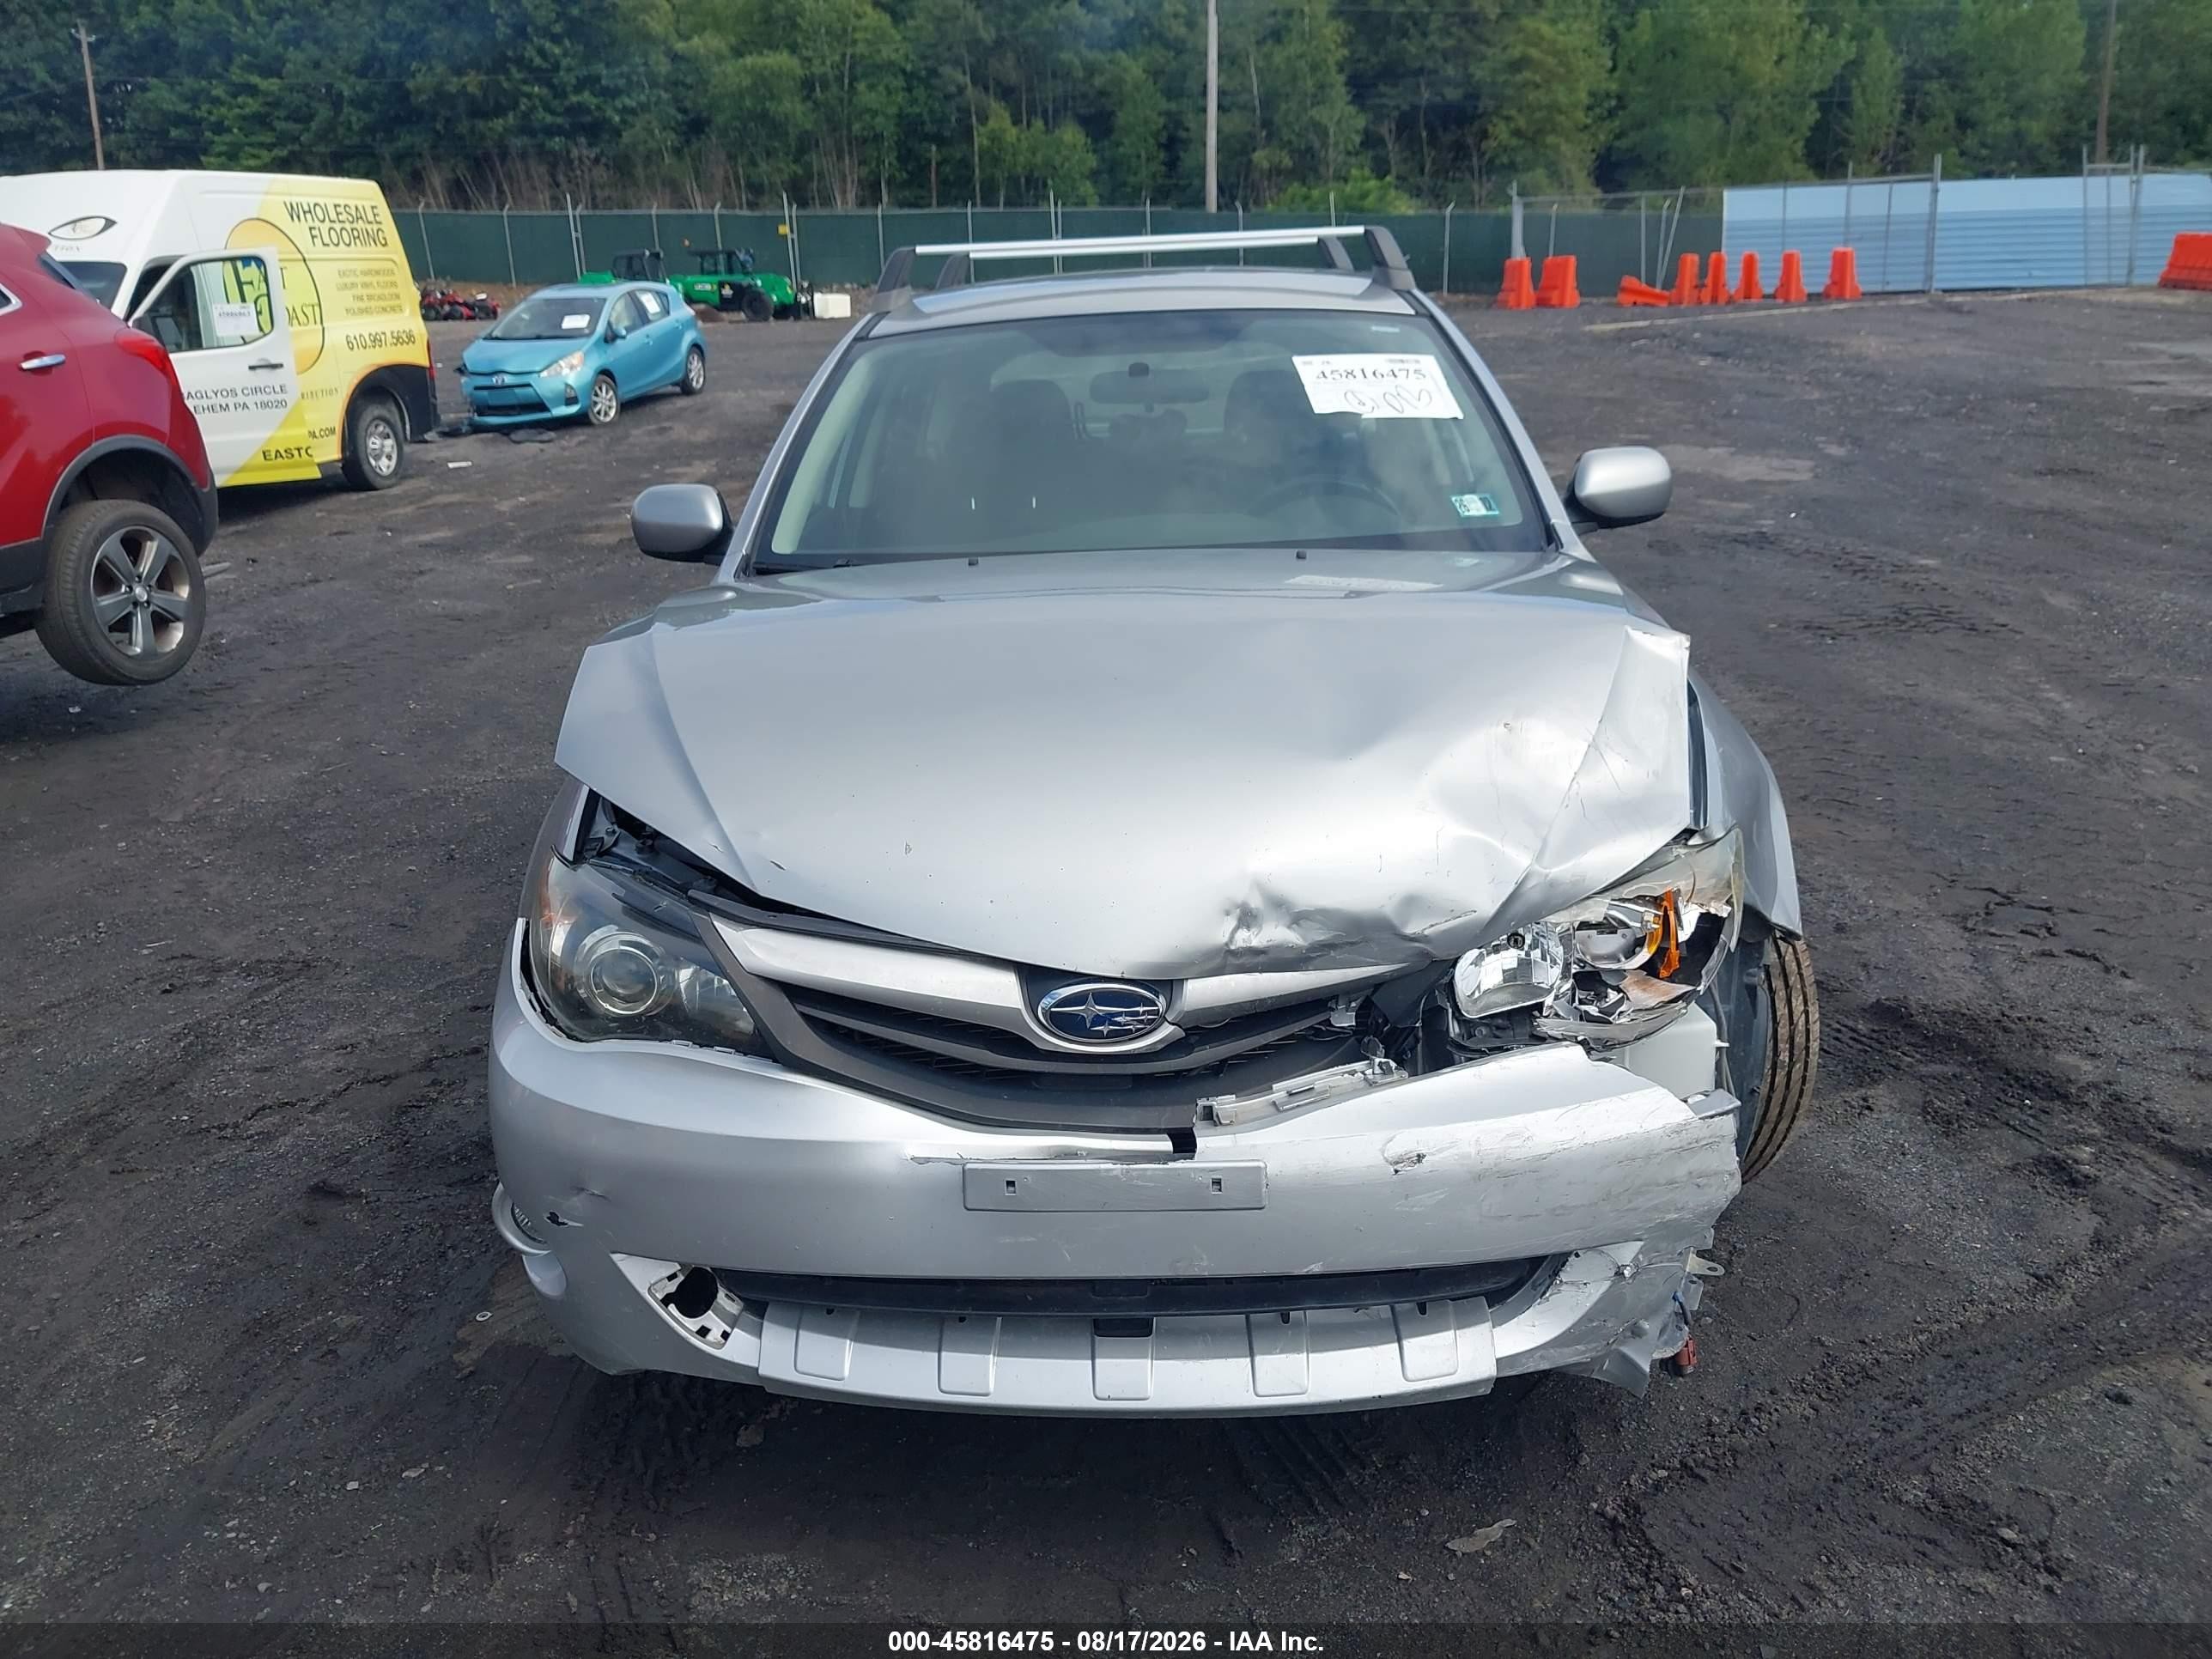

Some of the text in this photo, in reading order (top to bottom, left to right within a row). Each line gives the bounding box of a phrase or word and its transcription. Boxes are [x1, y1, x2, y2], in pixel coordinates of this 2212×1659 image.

[283, 200, 383, 225] WHOLESALE
[308, 226, 389, 247] FLOORING
[345, 329, 416, 351] 610.997.5636
[1316, 368, 1427, 381] 45816475
[241, 383, 288, 397] CIRCLE
[234, 401, 250, 411] PA
[254, 398, 288, 410] 18020
